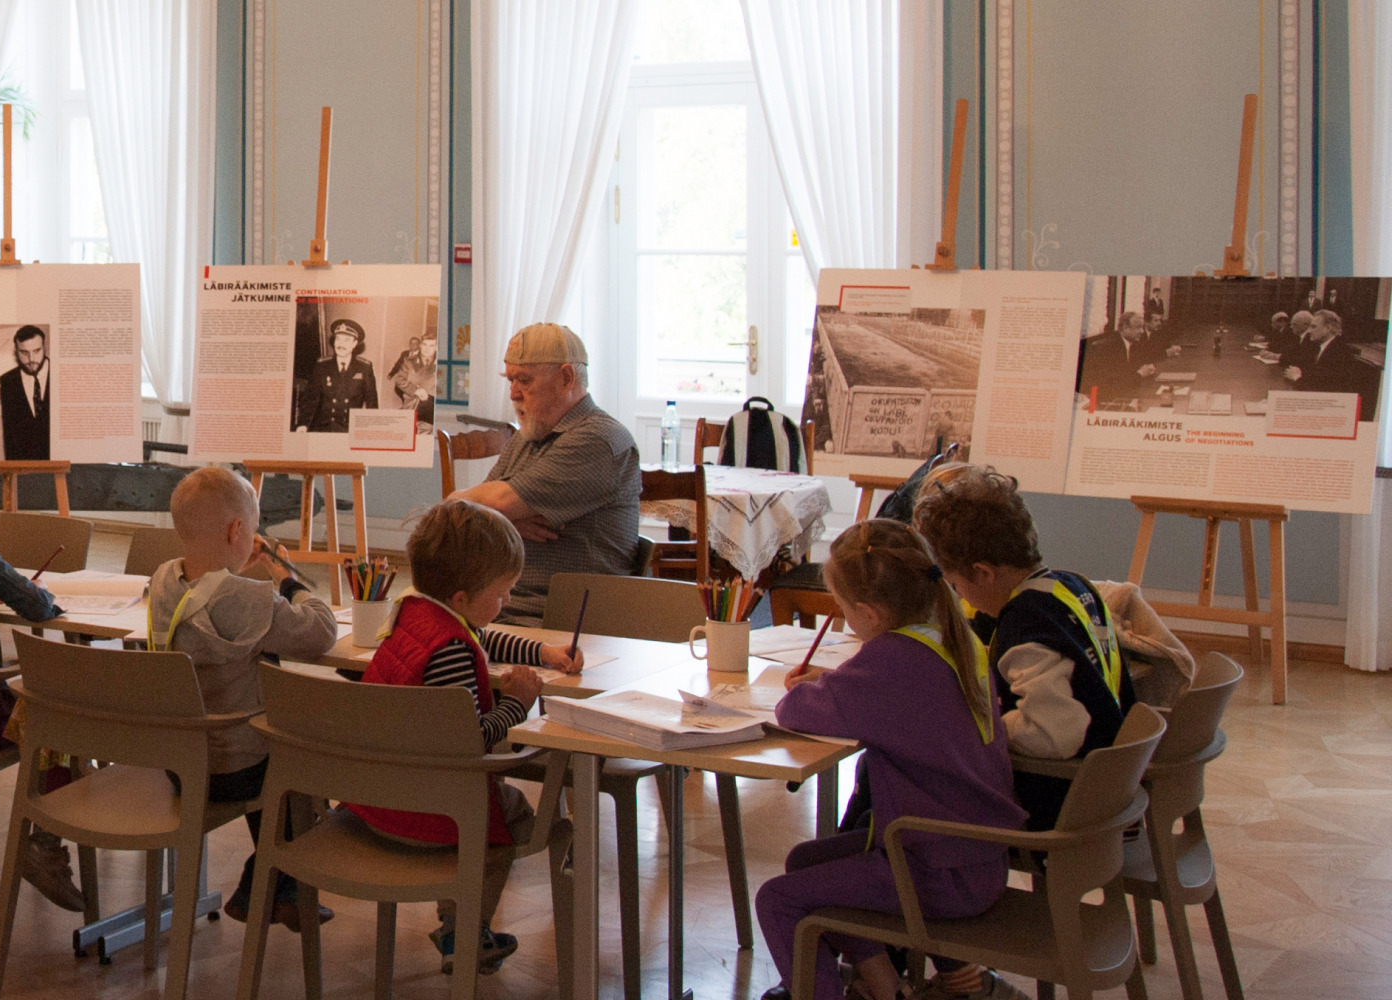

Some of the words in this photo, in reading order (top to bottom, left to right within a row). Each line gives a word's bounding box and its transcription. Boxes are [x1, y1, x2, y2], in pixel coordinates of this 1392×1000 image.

[203, 280, 292, 291] LÄBIRÄÄKIMISTE
[231, 292, 291, 303] JÄTKUMINE
[1086, 416, 1183, 430] LÄBIRÄÄKIMISTE
[1143, 433, 1182, 442] ALGUS
[1203, 431, 1245, 439] BEGINNING
[1197, 439, 1255, 447] NEGOTIATIONS
